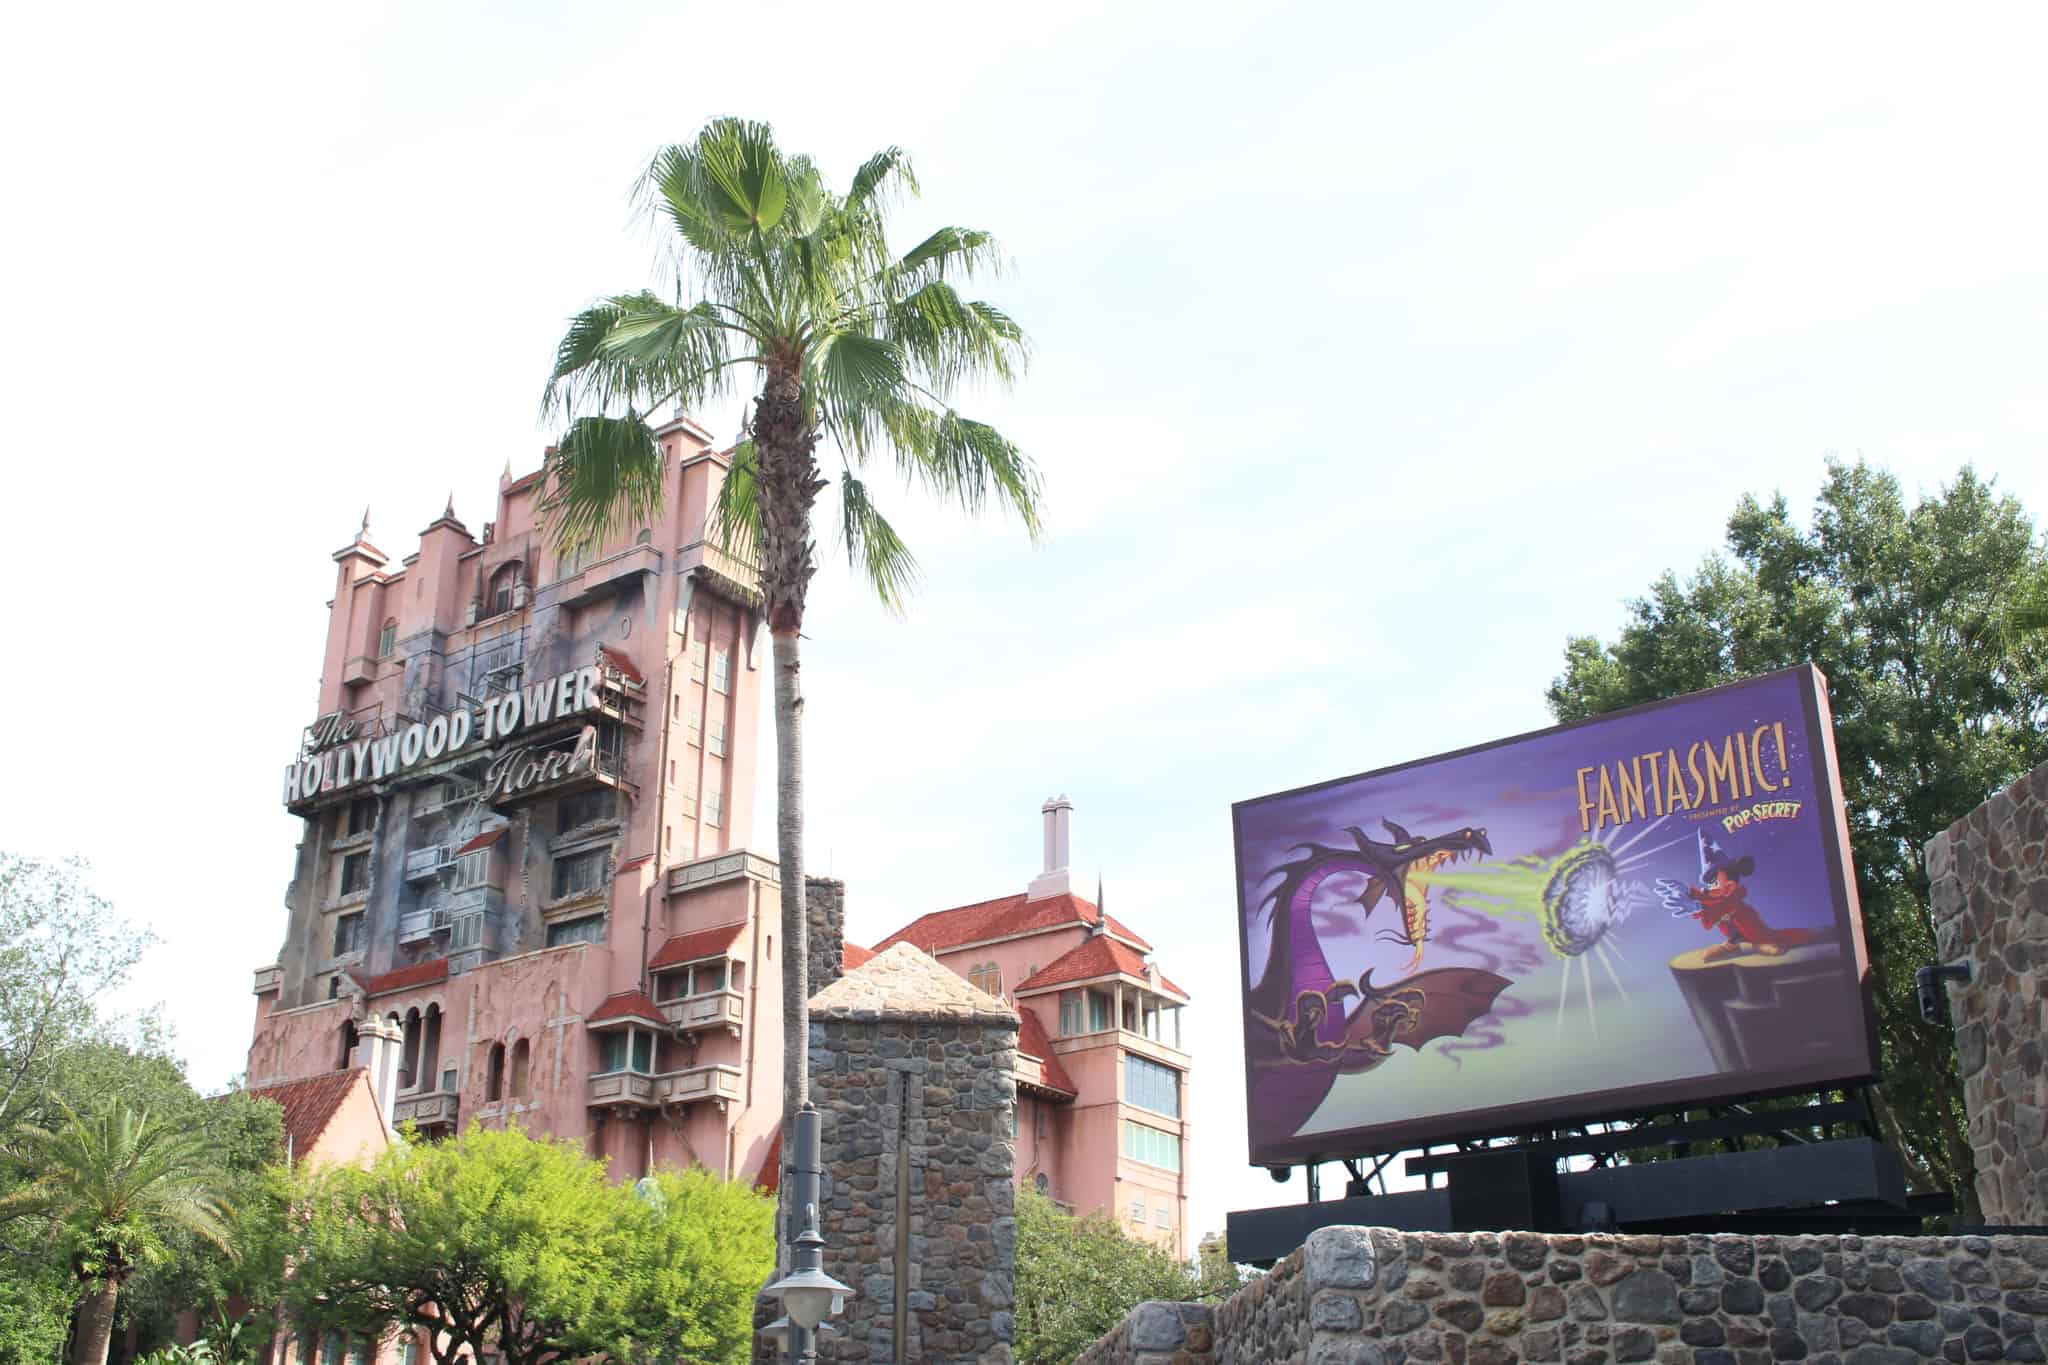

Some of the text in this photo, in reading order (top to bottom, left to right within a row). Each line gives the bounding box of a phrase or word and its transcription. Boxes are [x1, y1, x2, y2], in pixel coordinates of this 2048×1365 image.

[283, 666, 600, 804] HOLLYWOOD TOWER
[309, 711, 358, 754] The
[481, 724, 597, 801] Hotel
[1576, 721, 1791, 832] FANTASMIC!
